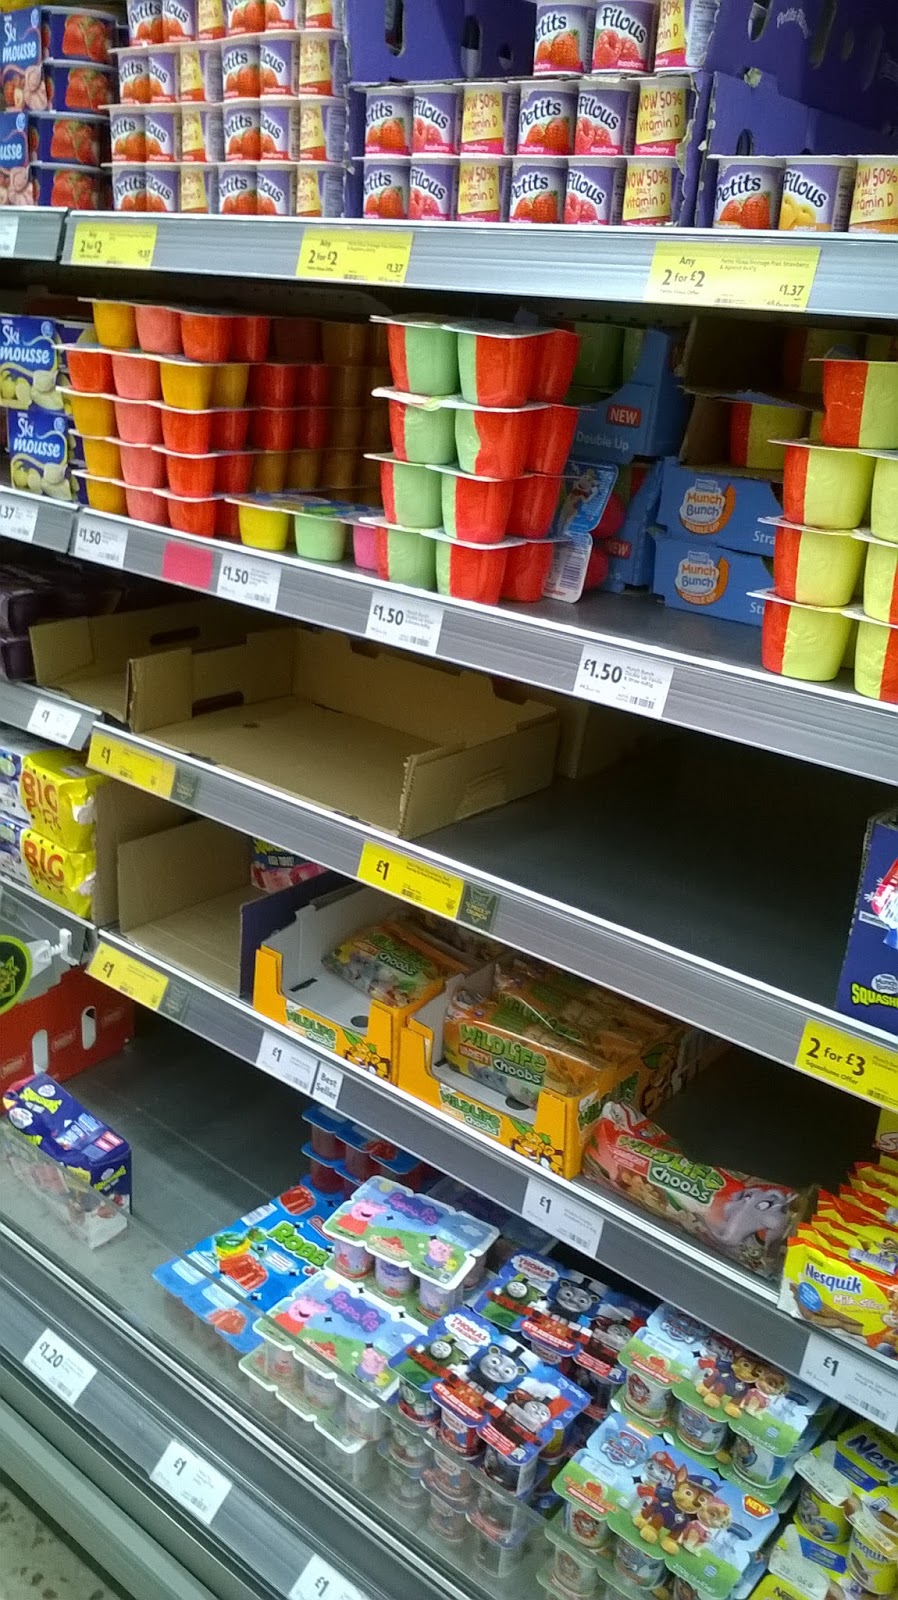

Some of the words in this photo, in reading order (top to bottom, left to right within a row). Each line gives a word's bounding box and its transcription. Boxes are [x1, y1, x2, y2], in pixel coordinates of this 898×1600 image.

[4, 23, 17, 46] Ski
[602, 7, 646, 43] Filous
[3, 41, 37, 62] mousse
[520, 98, 561, 132] Petits
[578, 96, 619, 130] Filous
[0, 143, 22, 160] usse
[873, 167, 897, 186] 50%
[568, 171, 605, 205] Filous
[717, 173, 762, 210] Petits
[784, 171, 827, 208] Filous
[80, 241, 86, 253] 2
[319, 239, 331, 248] Any
[308, 250, 316, 264] 2
[327, 251, 338, 266] £2
[679, 256, 696, 268] Any
[662, 269, 672, 286] 2
[674, 272, 688, 283] for
[690, 270, 706, 288] £2
[779, 284, 805, 297] £1.37
[2, 325, 20, 346] Ski
[0, 347, 50, 364] mousse
[610, 408, 638, 425] NEW
[17, 417, 33, 438] Ski
[14, 437, 61, 458] mousse
[687, 493, 722, 504] Munch
[686, 504, 719, 516] Bunch
[79, 528, 102, 546] £1.50
[223, 565, 250, 585] £1.50
[682, 564, 716, 576] Munch
[681, 576, 714, 588] Bunch
[373, 604, 404, 626] £1.50
[583, 659, 622, 684] £1.50
[101, 746, 111, 765] £1
[24, 840, 65, 882] BIG
[375, 859, 390, 881] £1
[102, 961, 115, 978] £1
[272, 1047, 282, 1063] £1
[806, 1037, 821, 1059] 2
[824, 1047, 843, 1062] for
[845, 1053, 866, 1076] £3
[321, 1072, 337, 1087] Best
[841, 1074, 858, 1085] Offer
[316, 1083, 337, 1100] Seller
[539, 1196, 552, 1214] £1
[518, 1256, 556, 1278] THOMAS
[806, 1263, 861, 1294] Nesquik
[453, 1315, 487, 1341] THOMAS
[39, 1341, 63, 1368] £1.20
[823, 1356, 840, 1377] £1
[173, 1457, 187, 1476] £1
[745, 1495, 770, 1514] NEW
[315, 1576, 330, 1597] £1
